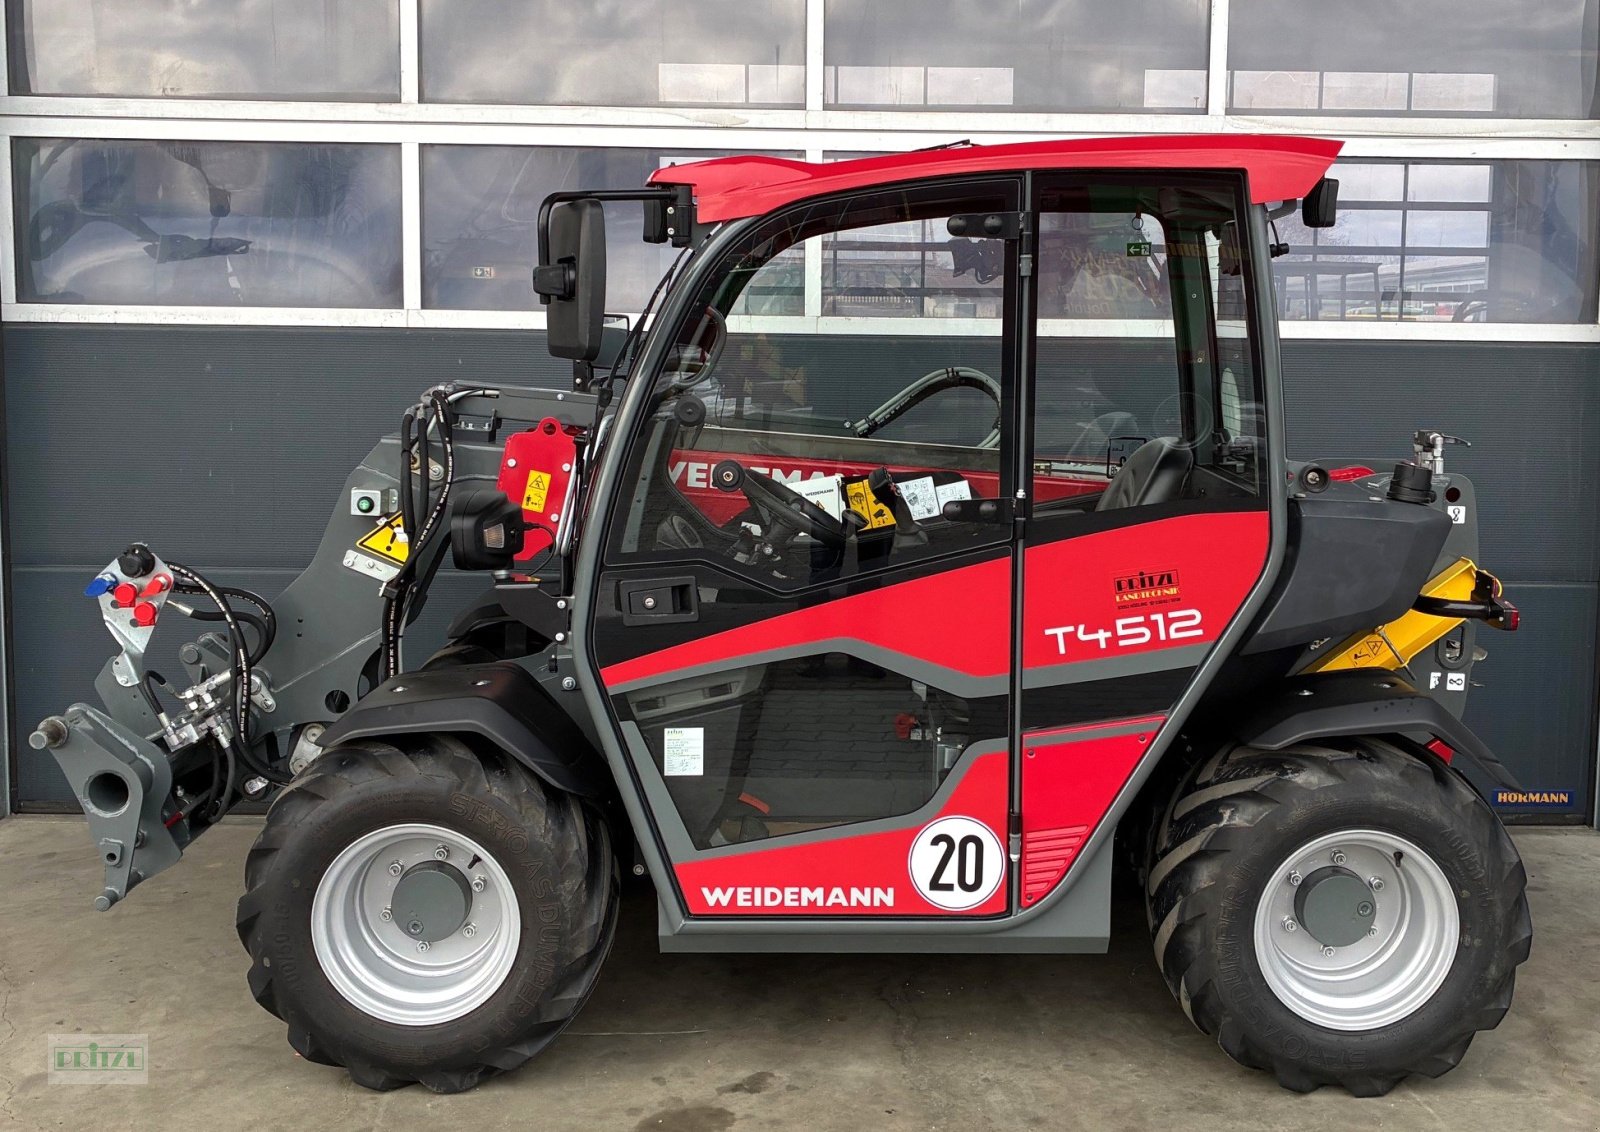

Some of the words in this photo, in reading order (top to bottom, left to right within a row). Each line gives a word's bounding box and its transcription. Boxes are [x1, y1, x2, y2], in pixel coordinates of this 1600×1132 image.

[1044, 608, 1203, 653] T4512
[929, 833, 984, 892] 20
[701, 887, 894, 907] WEIDEMANN
